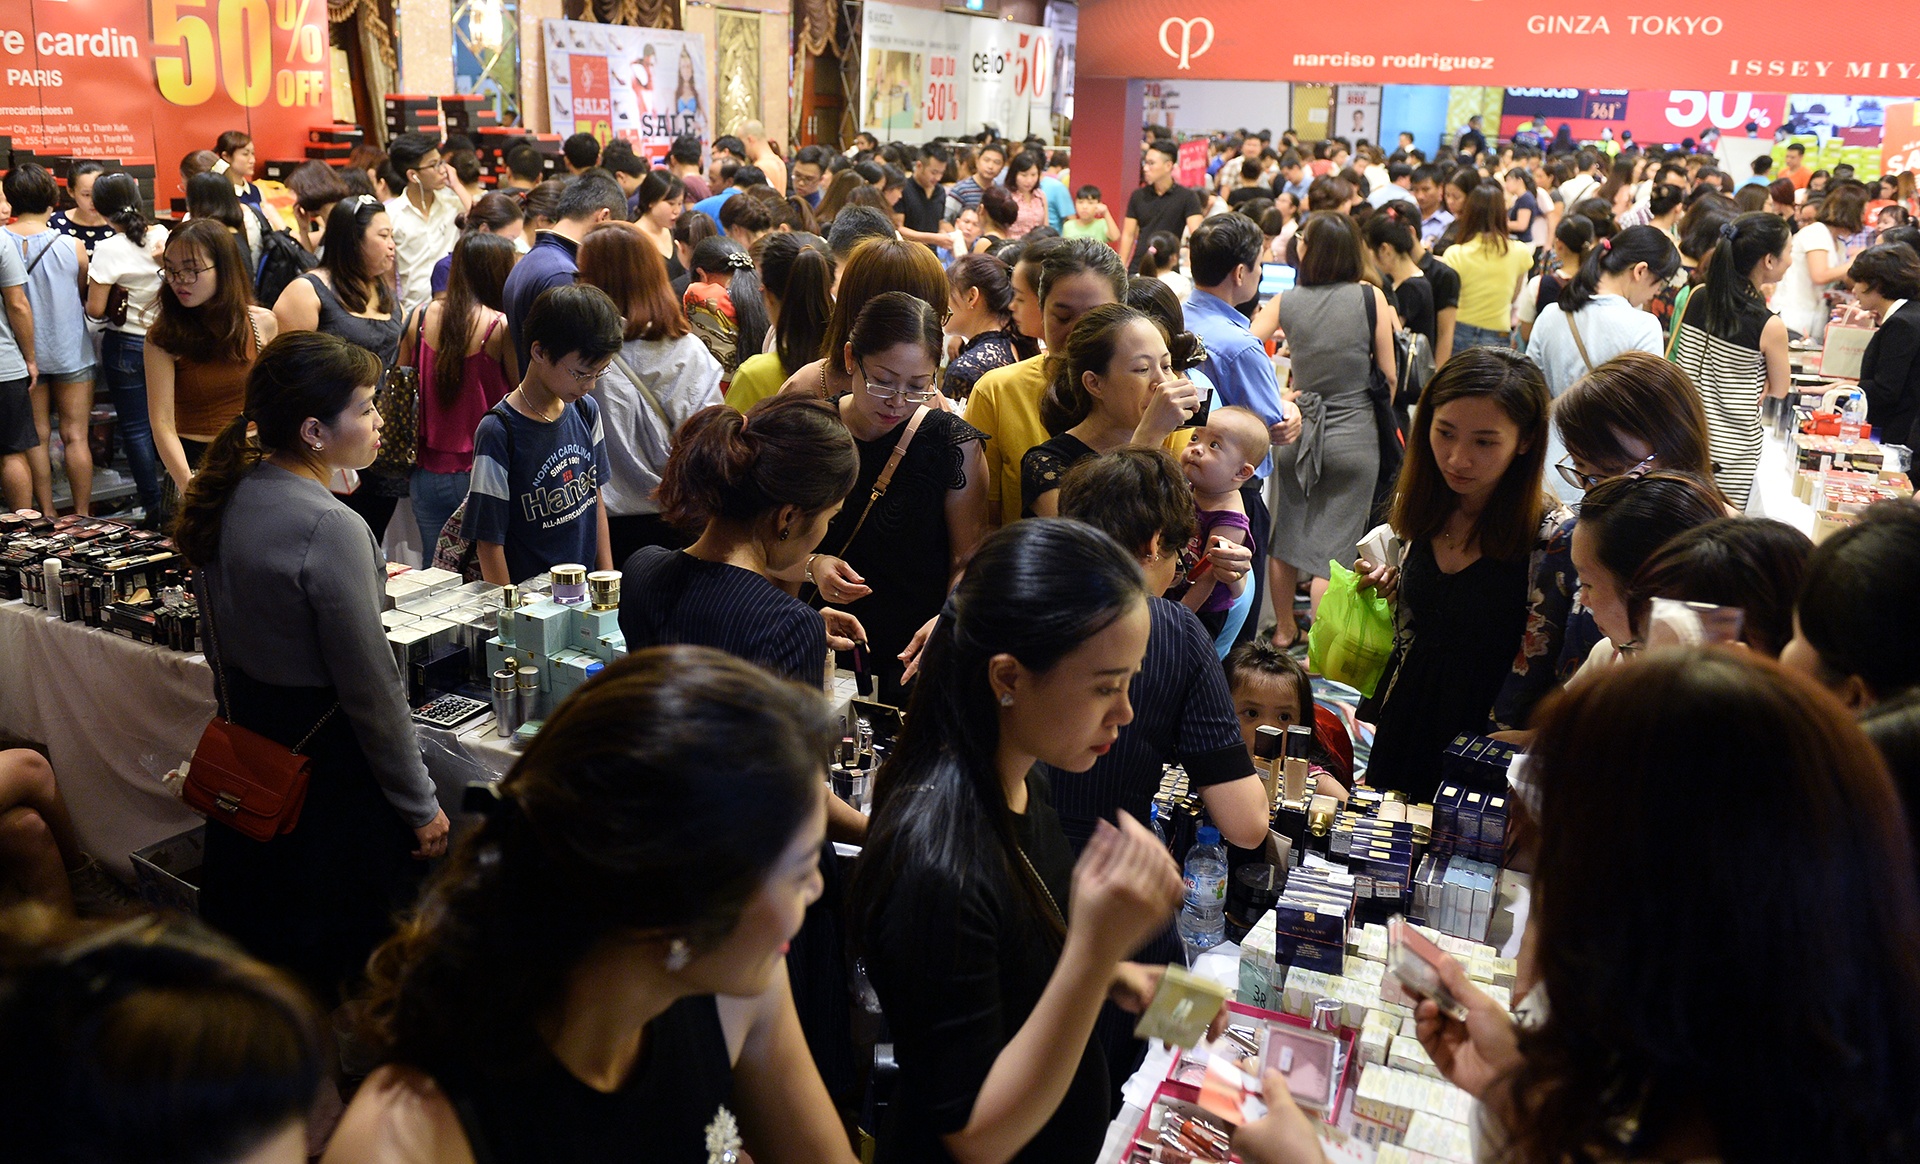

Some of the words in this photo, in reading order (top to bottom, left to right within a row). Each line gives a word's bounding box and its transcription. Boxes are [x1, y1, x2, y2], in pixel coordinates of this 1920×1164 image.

[1527, 15, 1610, 35] GINZA
[1627, 16, 1723, 36] TOKYO
[36, 28, 138, 57] cardin
[154, 0, 273, 107] 50
[930, 57, 945, 78] up
[946, 54, 957, 76] to
[1015, 33, 1047, 97] 50
[1293, 52, 1375, 67] narciso
[1382, 53, 1494, 72] rodriguez
[1729, 60, 1833, 77] ISSEY
[7, 69, 63, 87] PARIS
[276, 70, 324, 107] OFF
[574, 98, 610, 115] SALE
[643, 114, 697, 137] SALE
[532, 452, 558, 487] NORTH
[558, 443, 591, 462] CAROLINA
[549, 458, 568, 478] SINCE
[568, 456, 580, 465] 1901
[521, 464, 597, 522] Hanes
